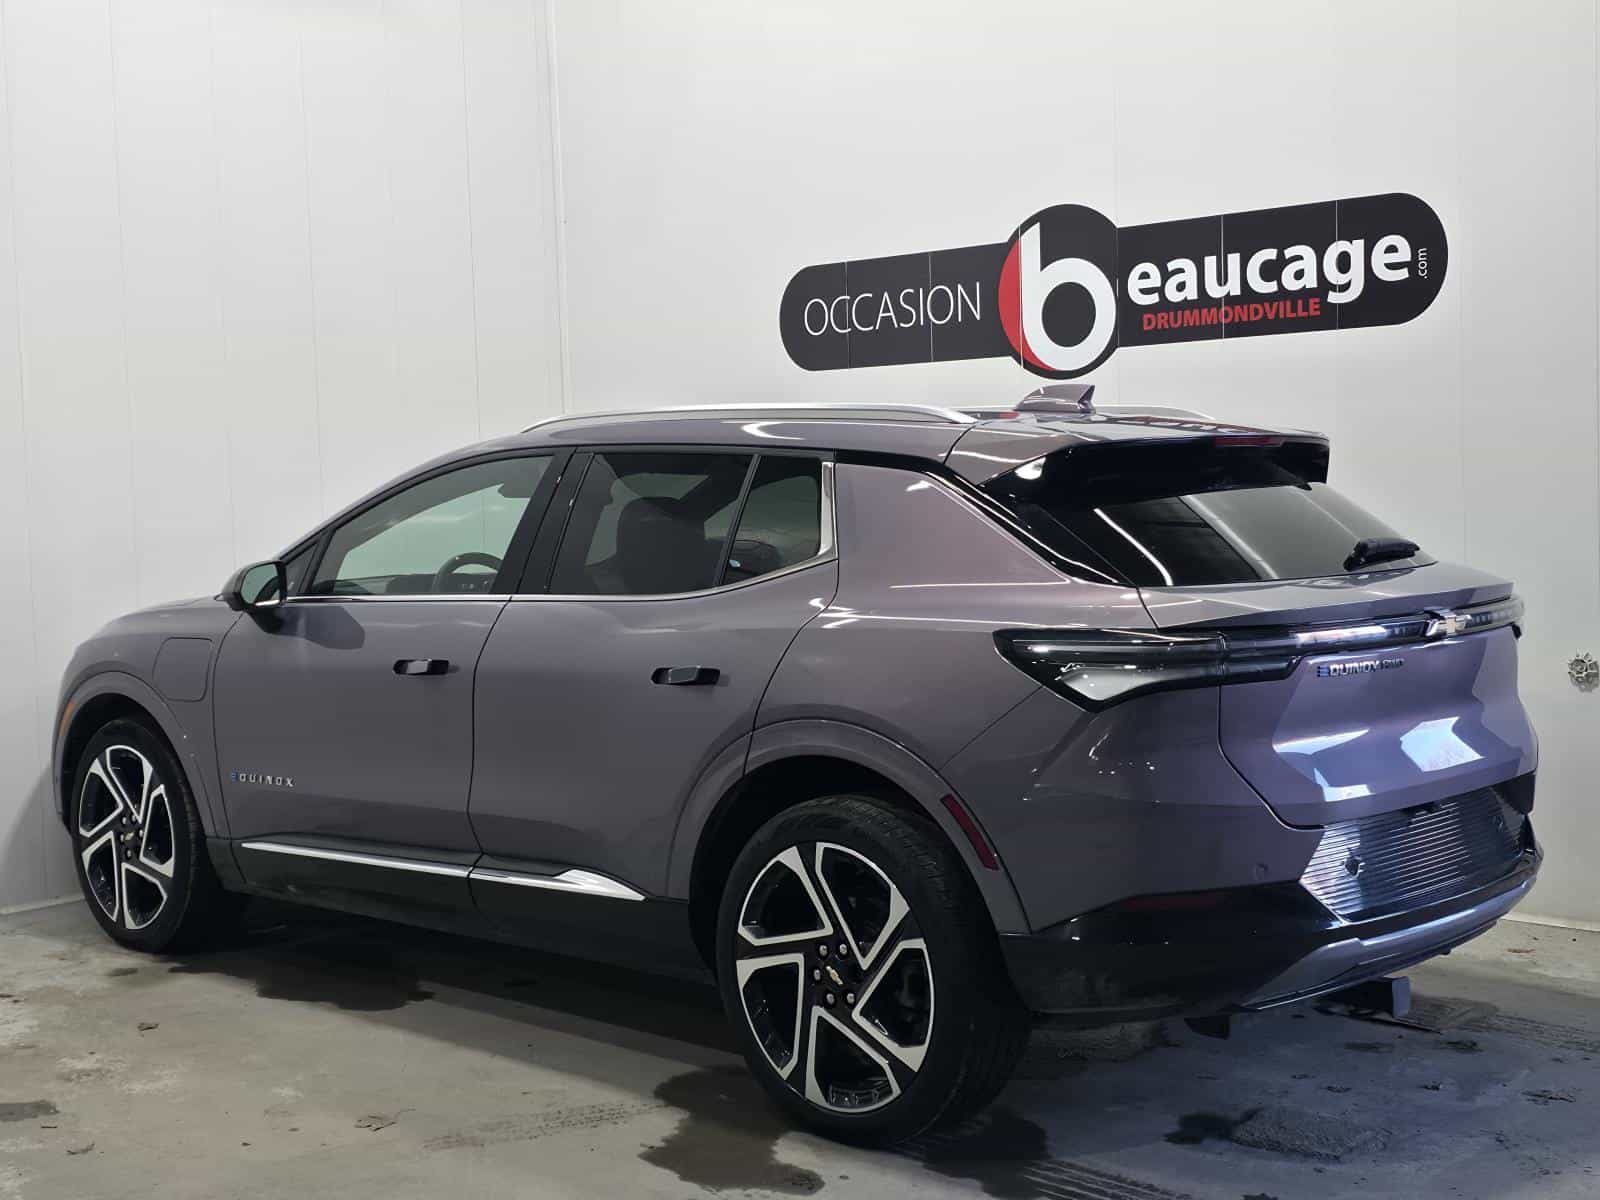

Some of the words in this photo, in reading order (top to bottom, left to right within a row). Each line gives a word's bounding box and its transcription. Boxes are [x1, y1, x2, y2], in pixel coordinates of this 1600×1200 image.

[803, 281, 981, 336] OCCASION
[1416, 247, 1428, 279] .com
[1142, 297, 1321, 331] DRUMMONDVILLE
[231, 771, 295, 787] EQUINOX
